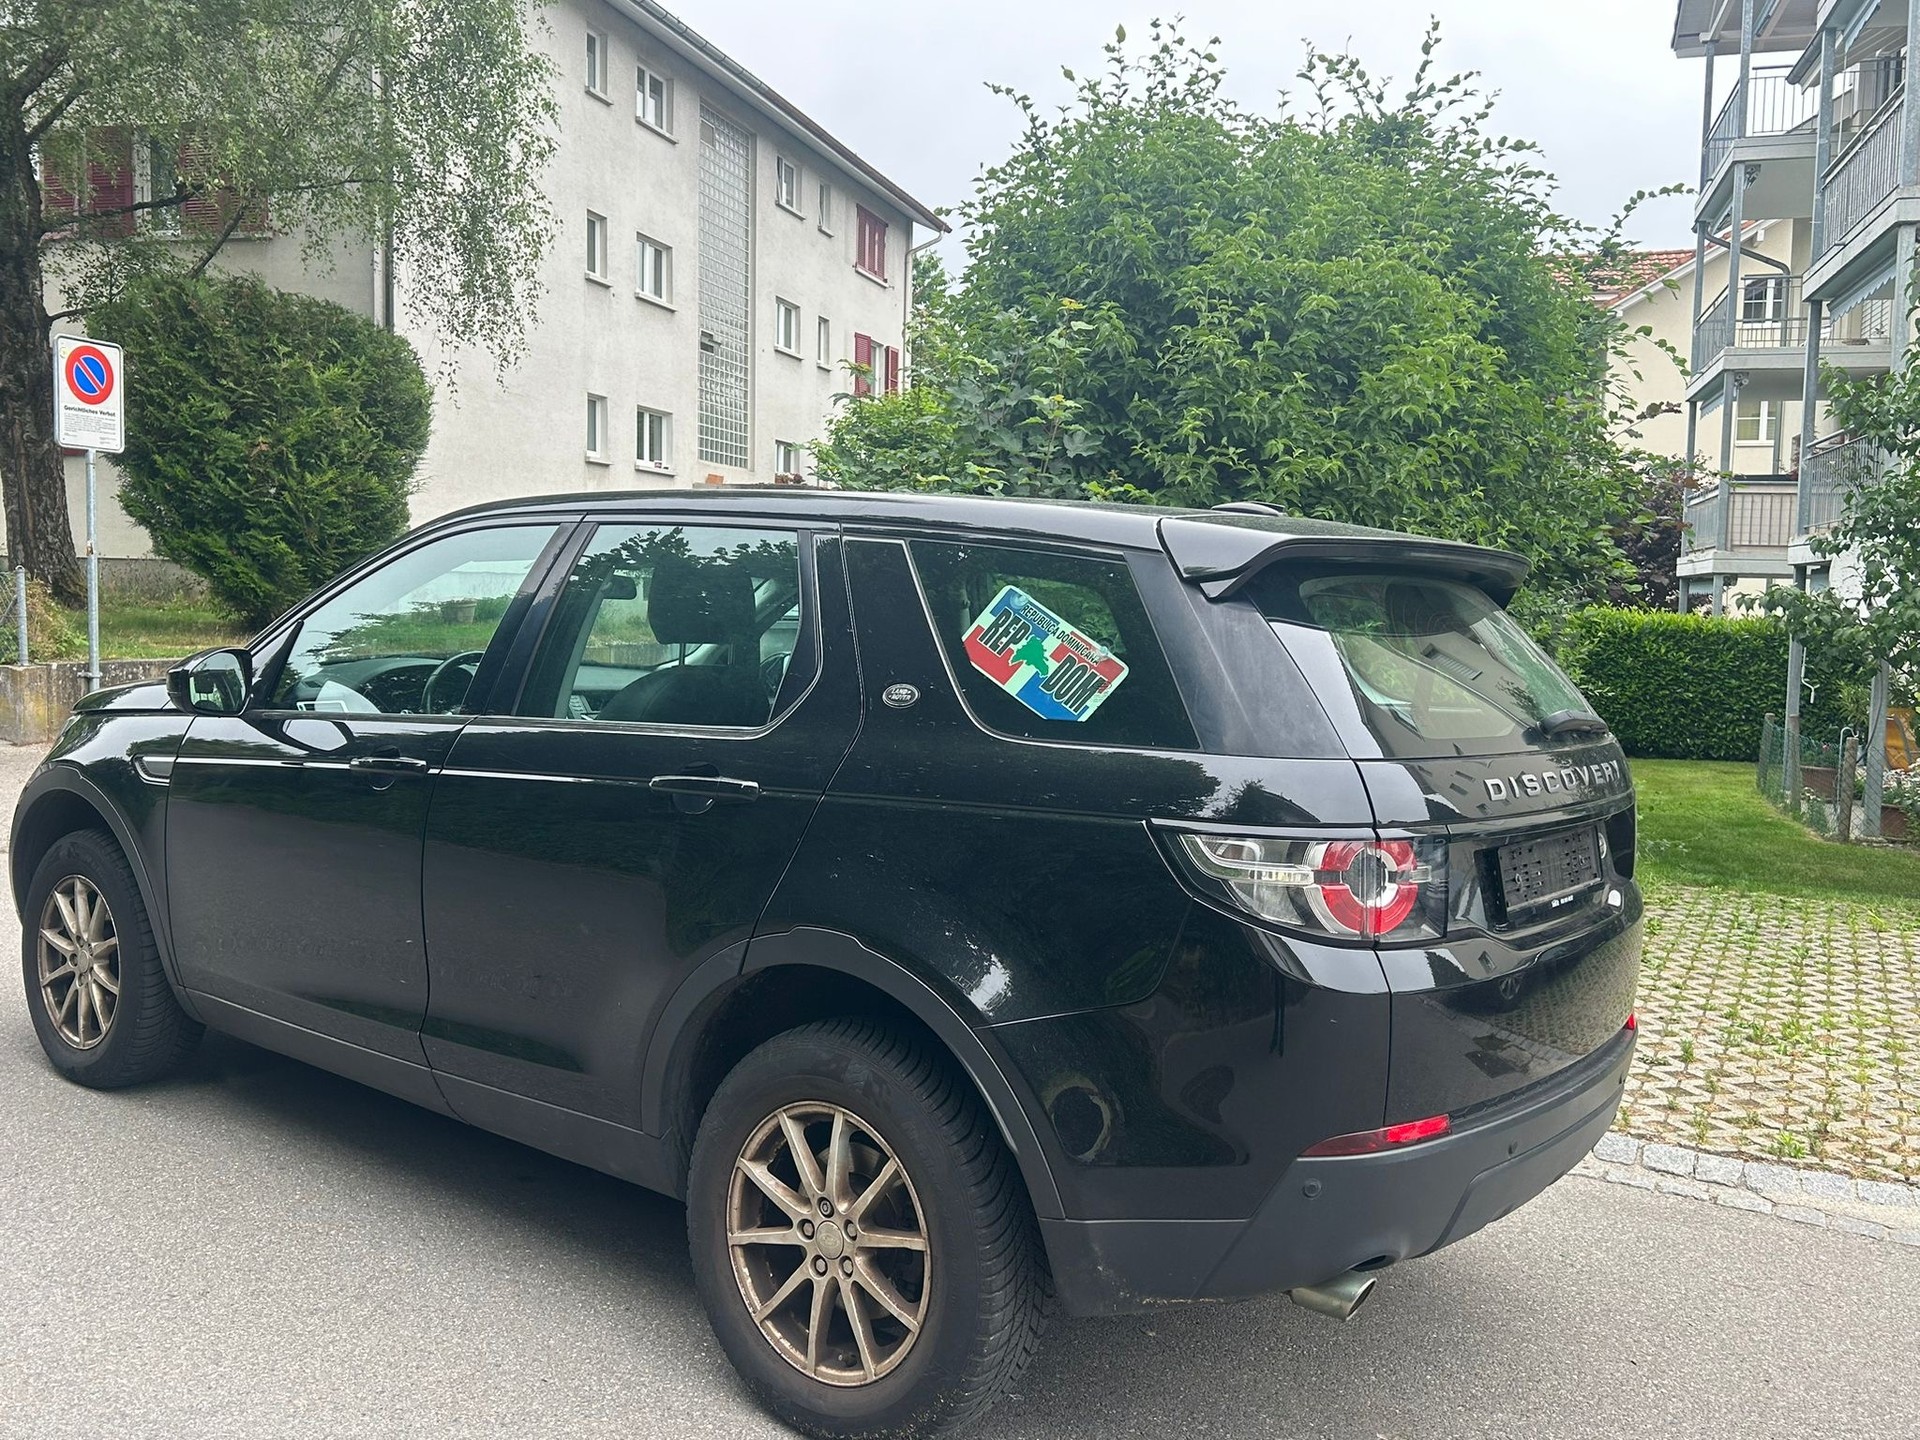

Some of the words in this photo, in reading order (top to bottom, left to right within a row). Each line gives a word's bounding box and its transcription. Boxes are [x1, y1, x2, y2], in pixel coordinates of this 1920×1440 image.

[978, 608, 1031, 656] REP
[1040, 654, 1107, 714] DOM
[1056, 630, 1100, 666] DOMINICANA
[1484, 760, 1620, 801] DISCOVERY
